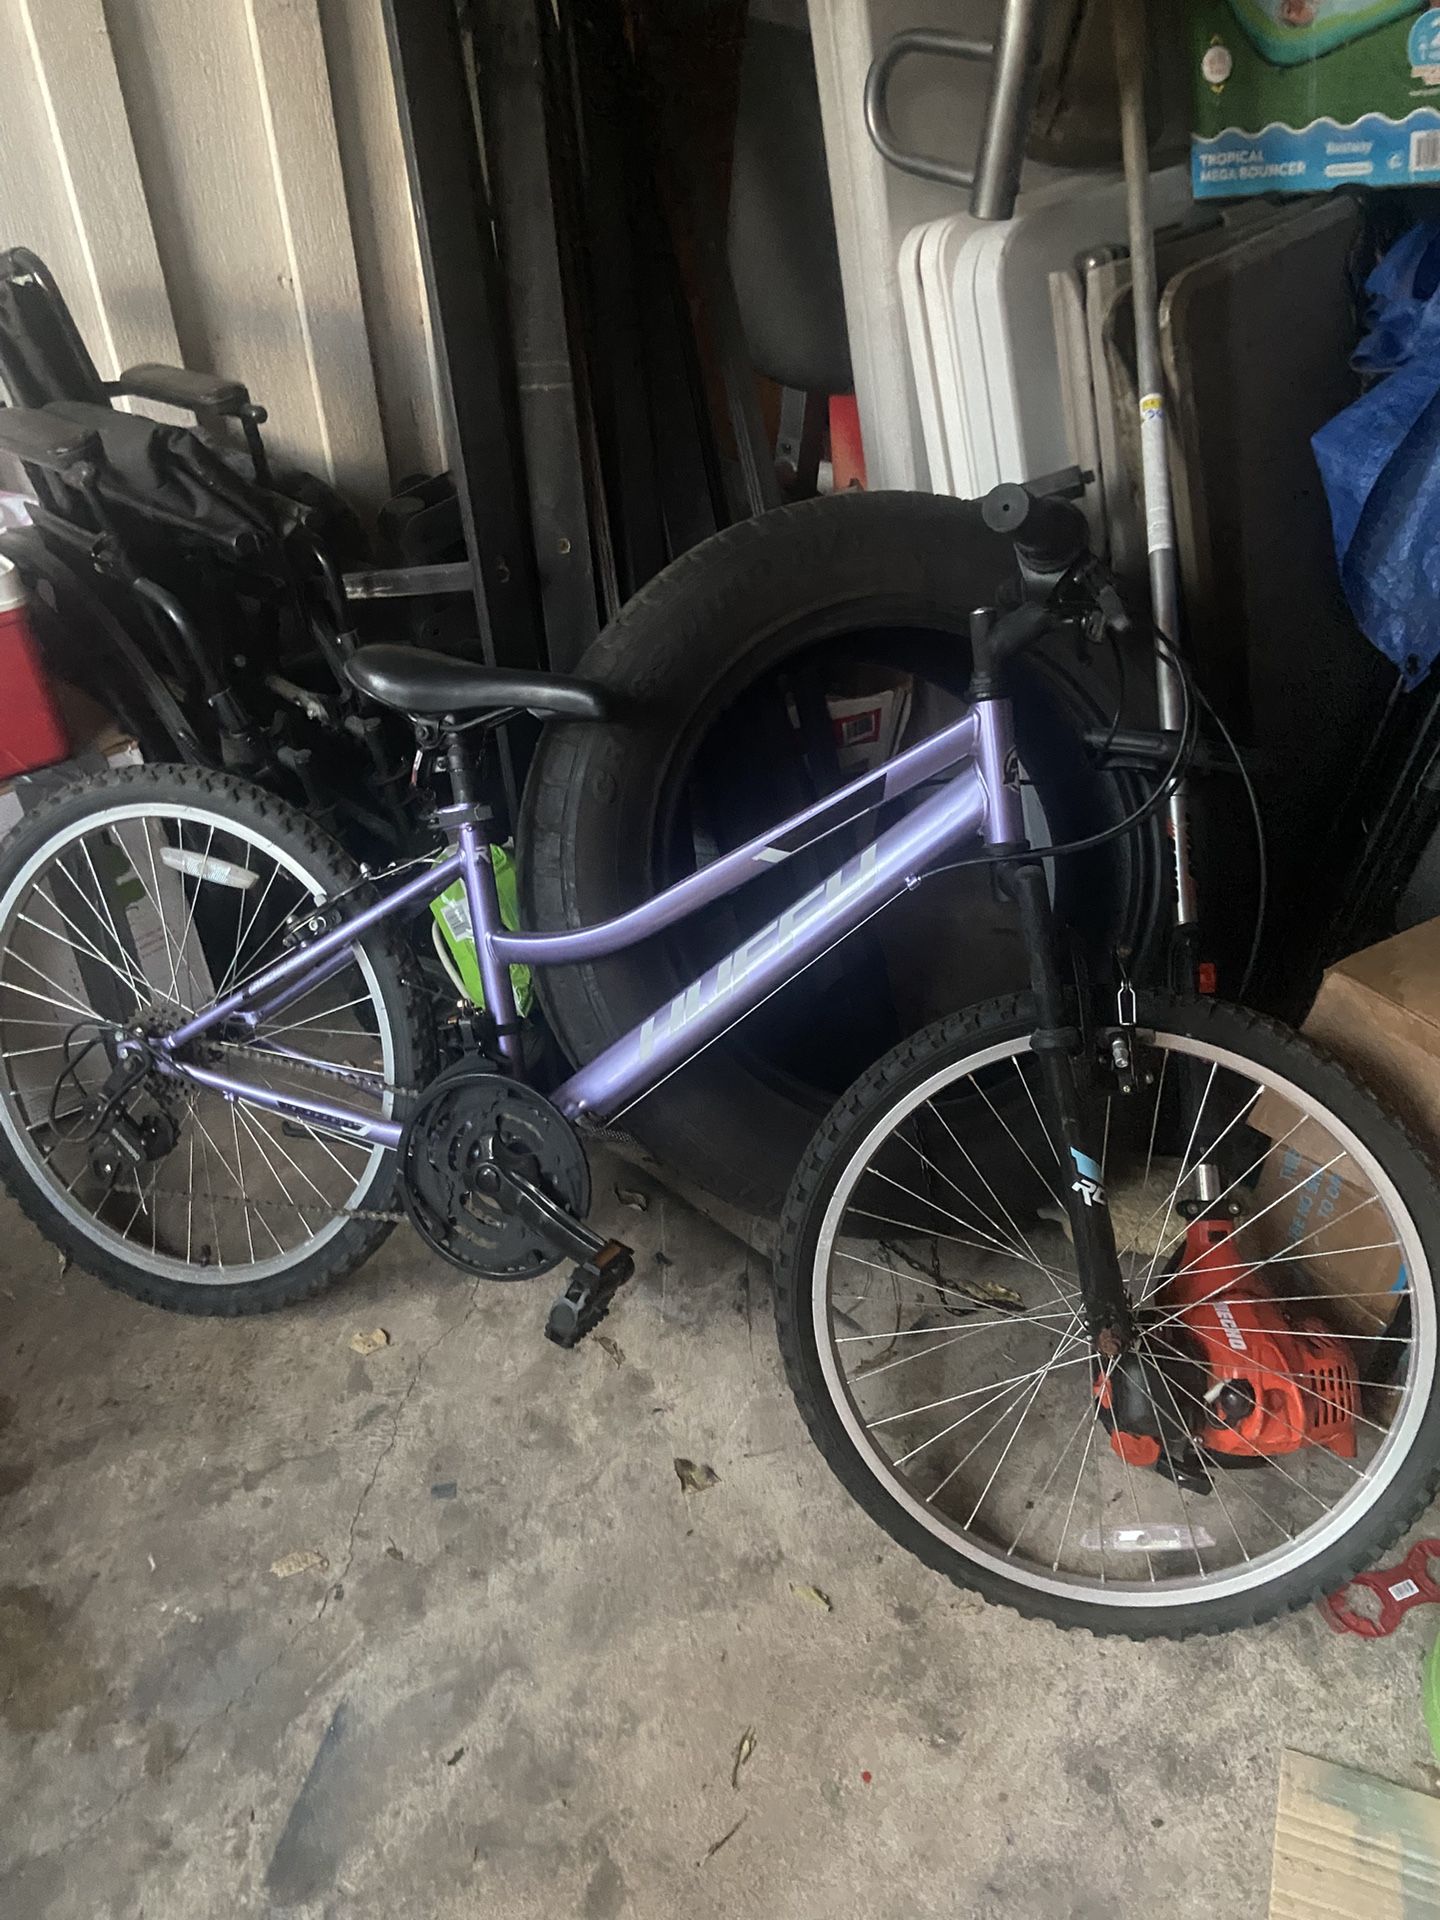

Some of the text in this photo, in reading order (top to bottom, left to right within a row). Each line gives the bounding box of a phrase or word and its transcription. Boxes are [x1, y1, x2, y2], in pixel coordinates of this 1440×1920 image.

[1200, 150, 1264, 167] TROPICAL
[1200, 166, 1238, 182] MEGA
[1239, 161, 1307, 179] BOUNCER
[639, 843, 877, 1060] HUFFY
[1215, 1308, 1247, 1350] ECHO
